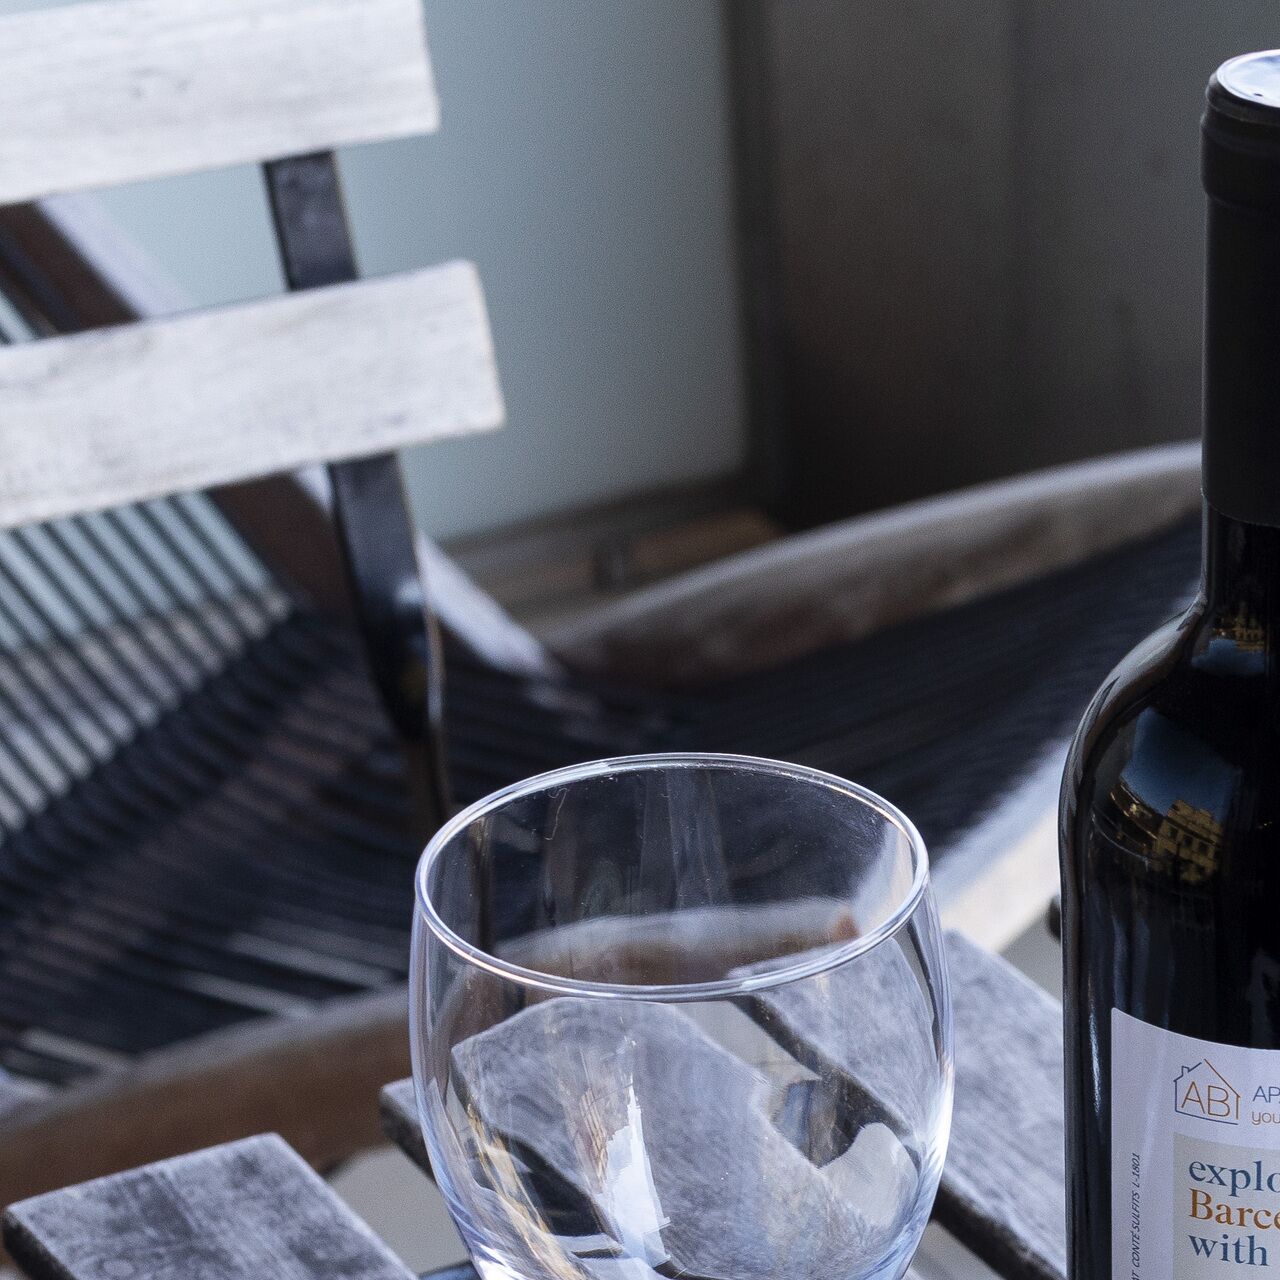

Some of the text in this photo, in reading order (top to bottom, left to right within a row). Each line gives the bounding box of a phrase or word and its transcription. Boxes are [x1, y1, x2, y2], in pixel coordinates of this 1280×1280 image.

[1131, 1152, 1141, 1188] L-1801
[1131, 1190, 1141, 1233] SULFITS
[1129, 1231, 1141, 1268] CONTÉ
[1188, 1233, 1270, 1267] with
